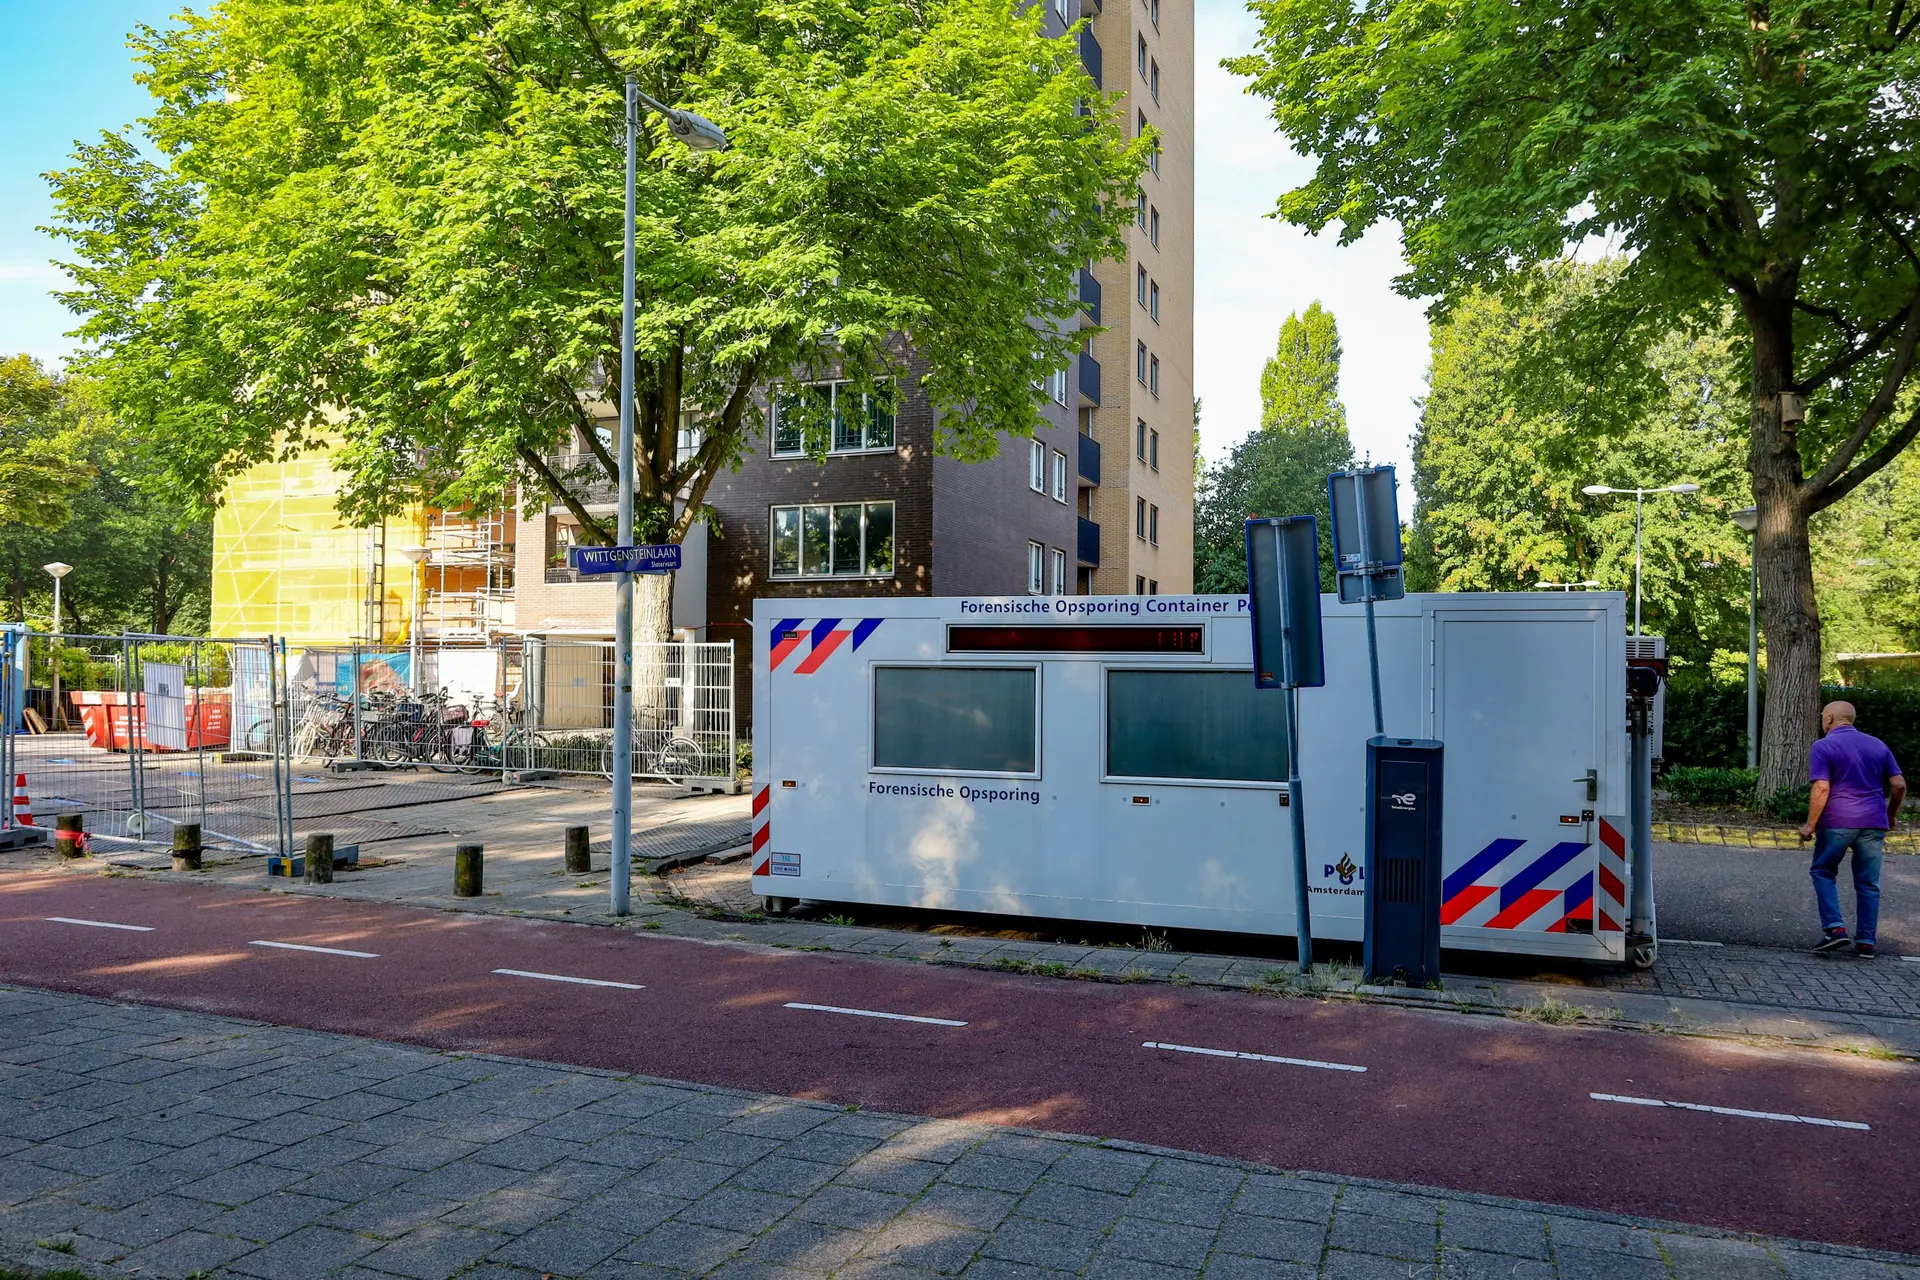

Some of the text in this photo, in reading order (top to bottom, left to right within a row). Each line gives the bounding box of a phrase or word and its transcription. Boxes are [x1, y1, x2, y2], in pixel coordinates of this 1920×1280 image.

[583, 547, 677, 563] WITTGENSTEINLAAN
[961, 599, 1050, 613] Forensische
[1055, 599, 1140, 616] Opsporing
[1146, 598, 1230, 613] Container
[869, 781, 1040, 805] Forensische Opsporing
